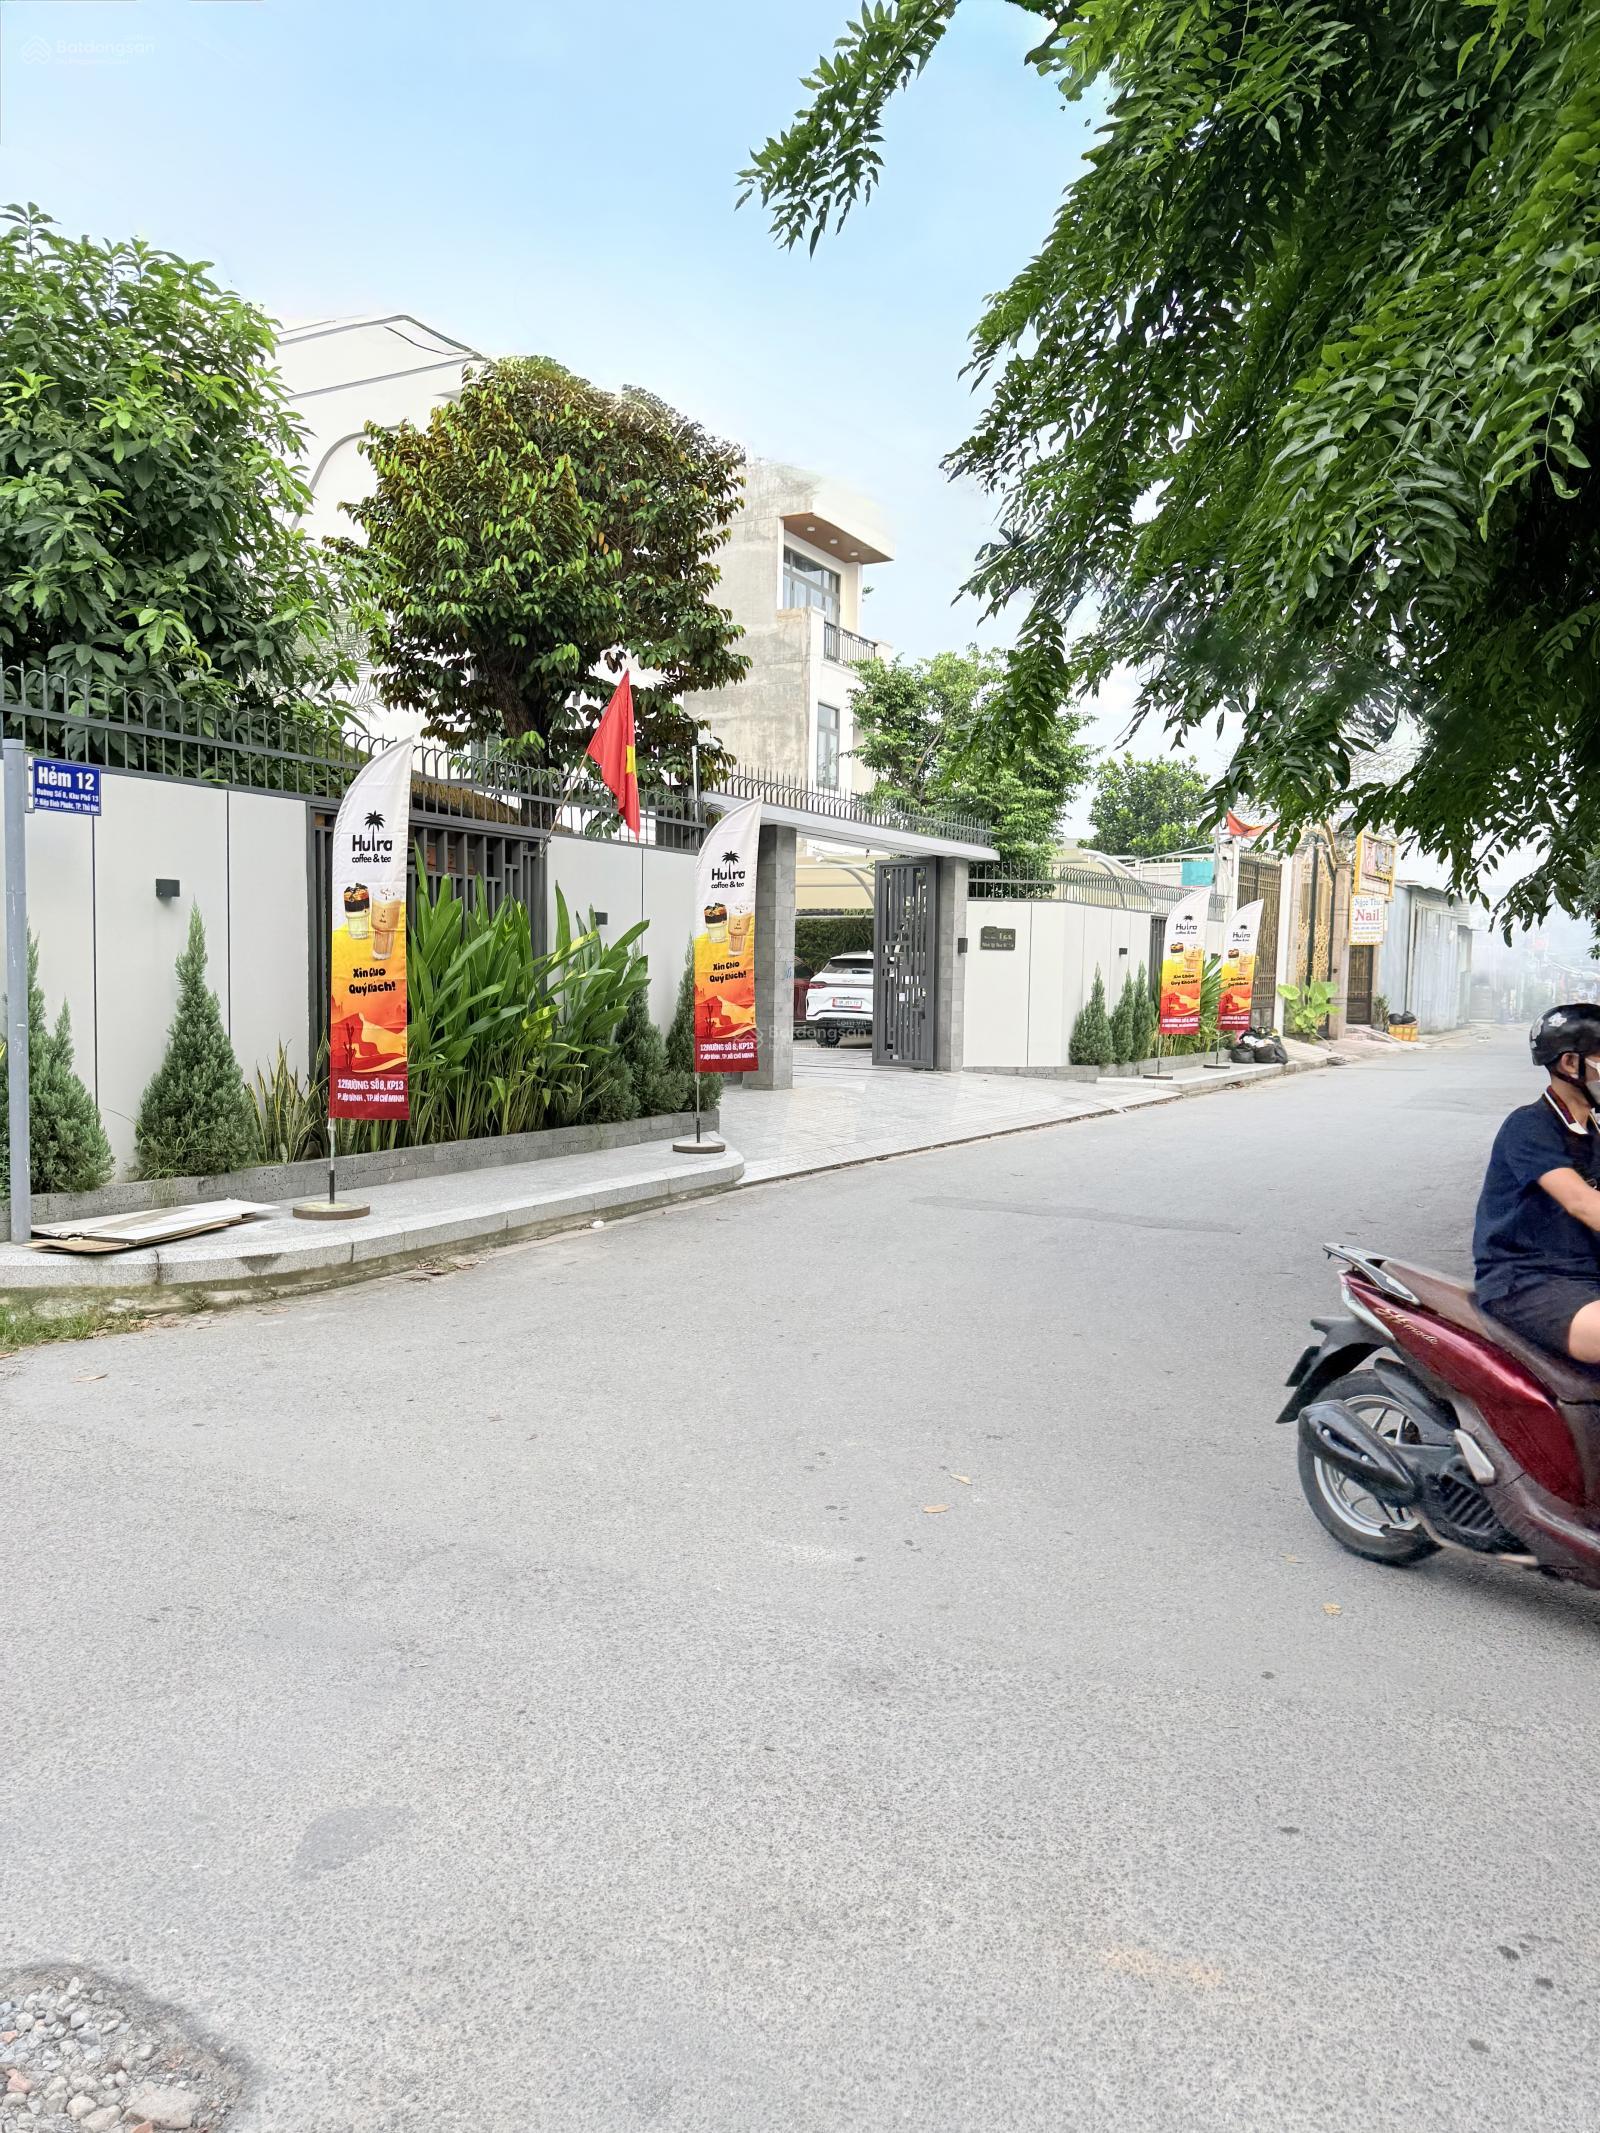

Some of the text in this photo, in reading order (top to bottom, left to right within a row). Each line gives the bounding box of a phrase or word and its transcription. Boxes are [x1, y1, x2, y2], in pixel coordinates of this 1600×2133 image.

[38, 766, 95, 791] Hẻm 12
[69, 792, 79, 800] Khu
[351, 853, 392, 863] coffee & tea
[711, 881, 729, 889] coffee
[729, 880, 736, 888] &
[1355, 909, 1380, 921] Nail
[353, 967, 369, 978] Xin
[713, 963, 726, 971] Xin
[709, 973, 725, 984] Quý
[348, 982, 368, 997] Quý
